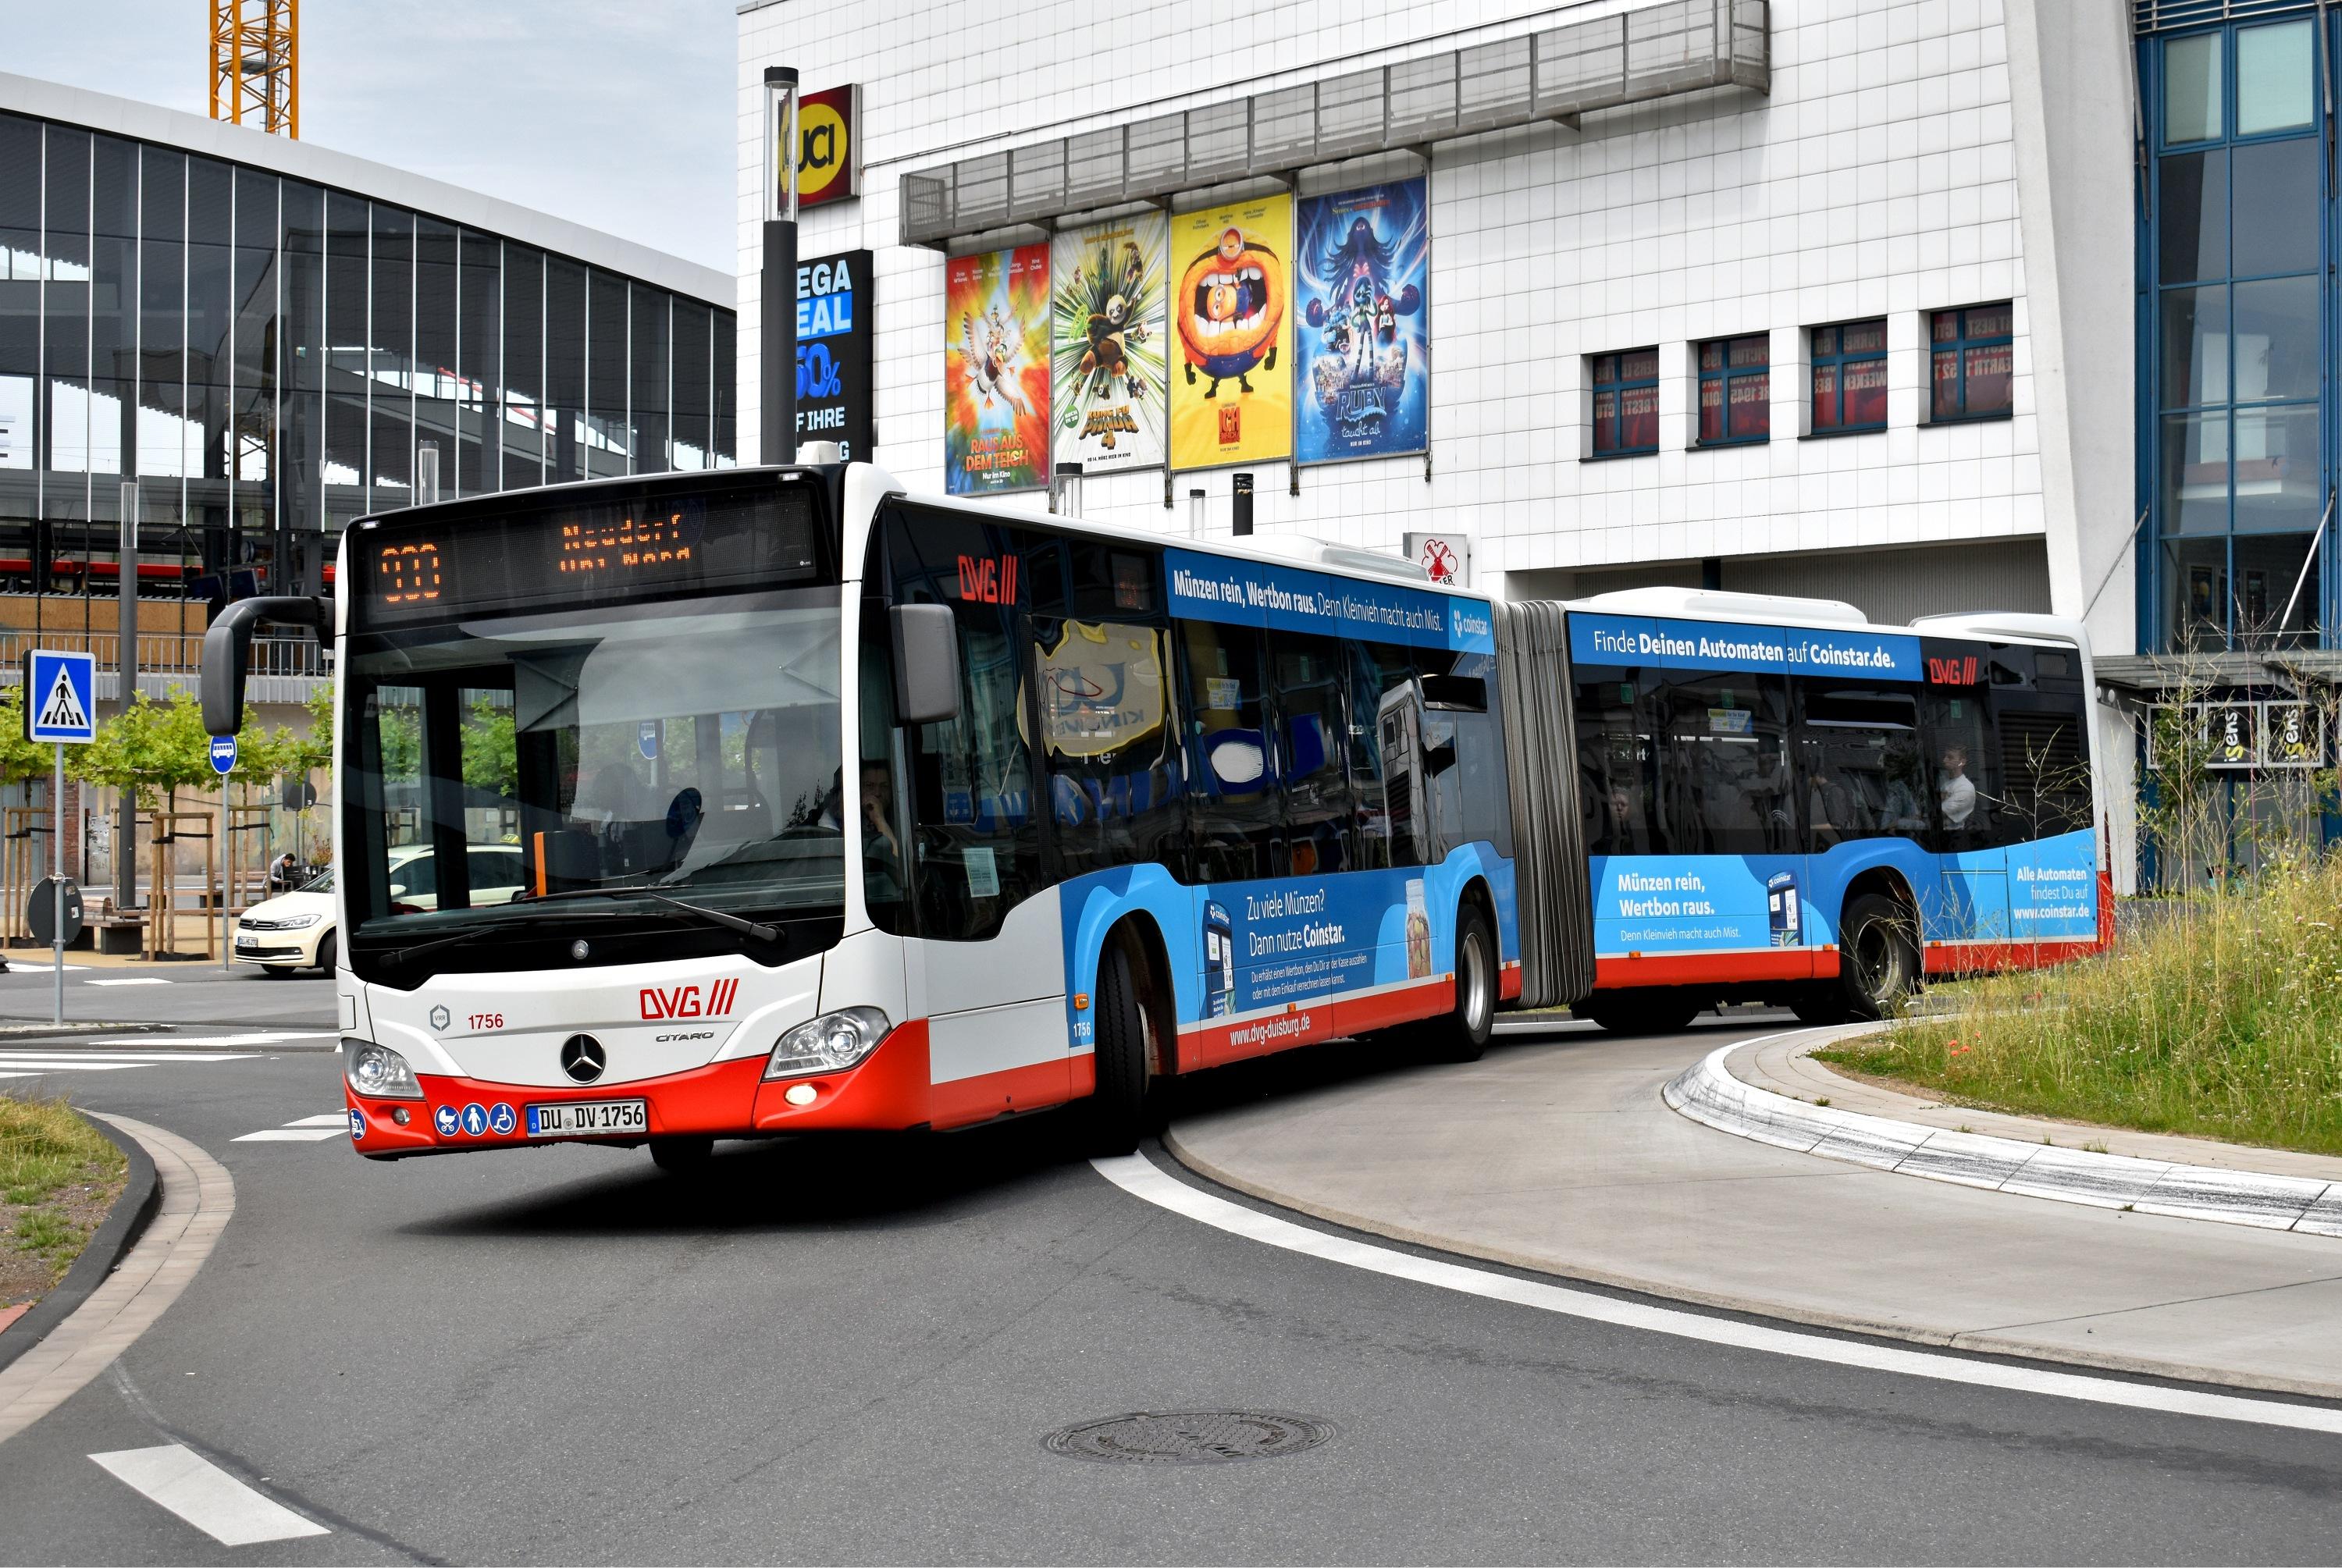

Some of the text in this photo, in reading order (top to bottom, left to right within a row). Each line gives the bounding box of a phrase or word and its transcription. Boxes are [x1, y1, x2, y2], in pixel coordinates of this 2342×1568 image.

[797, 259, 852, 300] EGA
[797, 297, 852, 338] EAL
[1087, 405, 1130, 420] KUNG FU
[1336, 387, 1386, 421] RUBY
[807, 407, 845, 431] IHRE
[1079, 414, 1139, 440] PANDA
[1219, 407, 1240, 432] ICH
[1341, 421, 1380, 438] taucht ab
[971, 434, 1023, 453] RAUS AUS
[1101, 429, 1116, 450] 4
[966, 449, 1029, 471] DEM TEICH
[999, 470, 1011, 478] Kino
[958, 555, 998, 603] DVG
[1173, 569, 1443, 631] Münzen rein, Wertbon raus. Denn Kleinvieh macht auch Mist.
[1463, 613, 1487, 635] coinstar
[1594, 630, 1895, 668] Finde Deinen Automaten auf Coinstar.de.
[1929, 657, 1960, 684] DVG
[1618, 871, 1705, 893] Münzen rein,
[1774, 874, 1791, 884] coinstar
[2016, 866, 2087, 881] Alle Automaten
[2031, 884, 2088, 900] findest Du auf
[1247, 888, 1325, 920] Zu viele Münzen?
[1619, 896, 1715, 916] Wertbon raus.
[2013, 902, 2090, 919] www.coinstar.de
[1215, 908, 1230, 925] coinstar
[1249, 920, 1345, 957] Dann nutze Coinstar.
[1621, 926, 1742, 941] Denn Kleinvieh macht auch Mist.
[1251, 971, 1258, 983] Du
[1273, 968, 1286, 978] einen
[1286, 965, 1304, 977] Wertbon,
[1304, 963, 1313, 973] den
[1313, 961, 1319, 972] Du
[1338, 957, 1348, 968] Kasse
[1349, 954, 1367, 966] auszahlen
[1252, 987, 1263, 1000] oder
[1271, 983, 1281, 997] dem
[1281, 980, 1297, 994] Einkauf
[1296, 977, 1319, 990] verrechnen
[1319, 976, 1331, 987] lassen
[1331, 973, 1346, 986] kannst.
[640, 986, 700, 1019] DVG
[468, 1013, 504, 1029] 1756
[1073, 1022, 1091, 1037] 1756
[1230, 1012, 1310, 1046] www.dvg-duisburg.de
[656, 1031, 714, 1043] CITARO
[539, 1108, 561, 1130] DU
